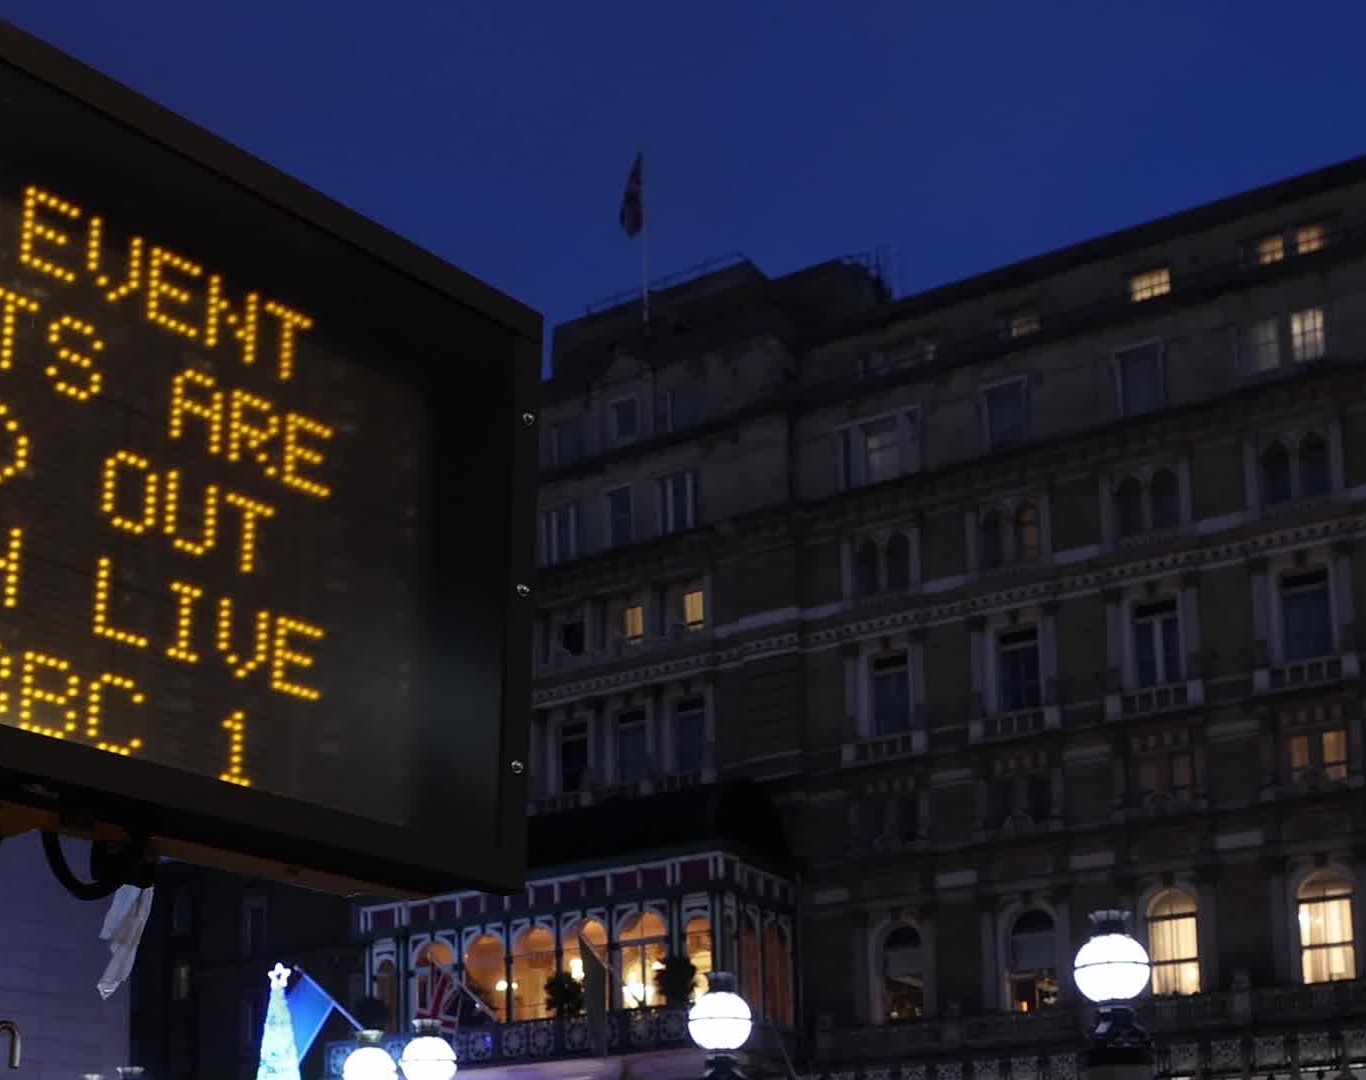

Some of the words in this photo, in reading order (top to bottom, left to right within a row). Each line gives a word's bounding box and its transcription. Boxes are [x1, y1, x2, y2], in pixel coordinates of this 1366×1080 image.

[19, 186, 314, 380] EVENT
[169, 369, 333, 499] ARE
[101, 450, 275, 573] OUT
[92, 557, 324, 701] LIVE
[218, 710, 251, 788] 1
